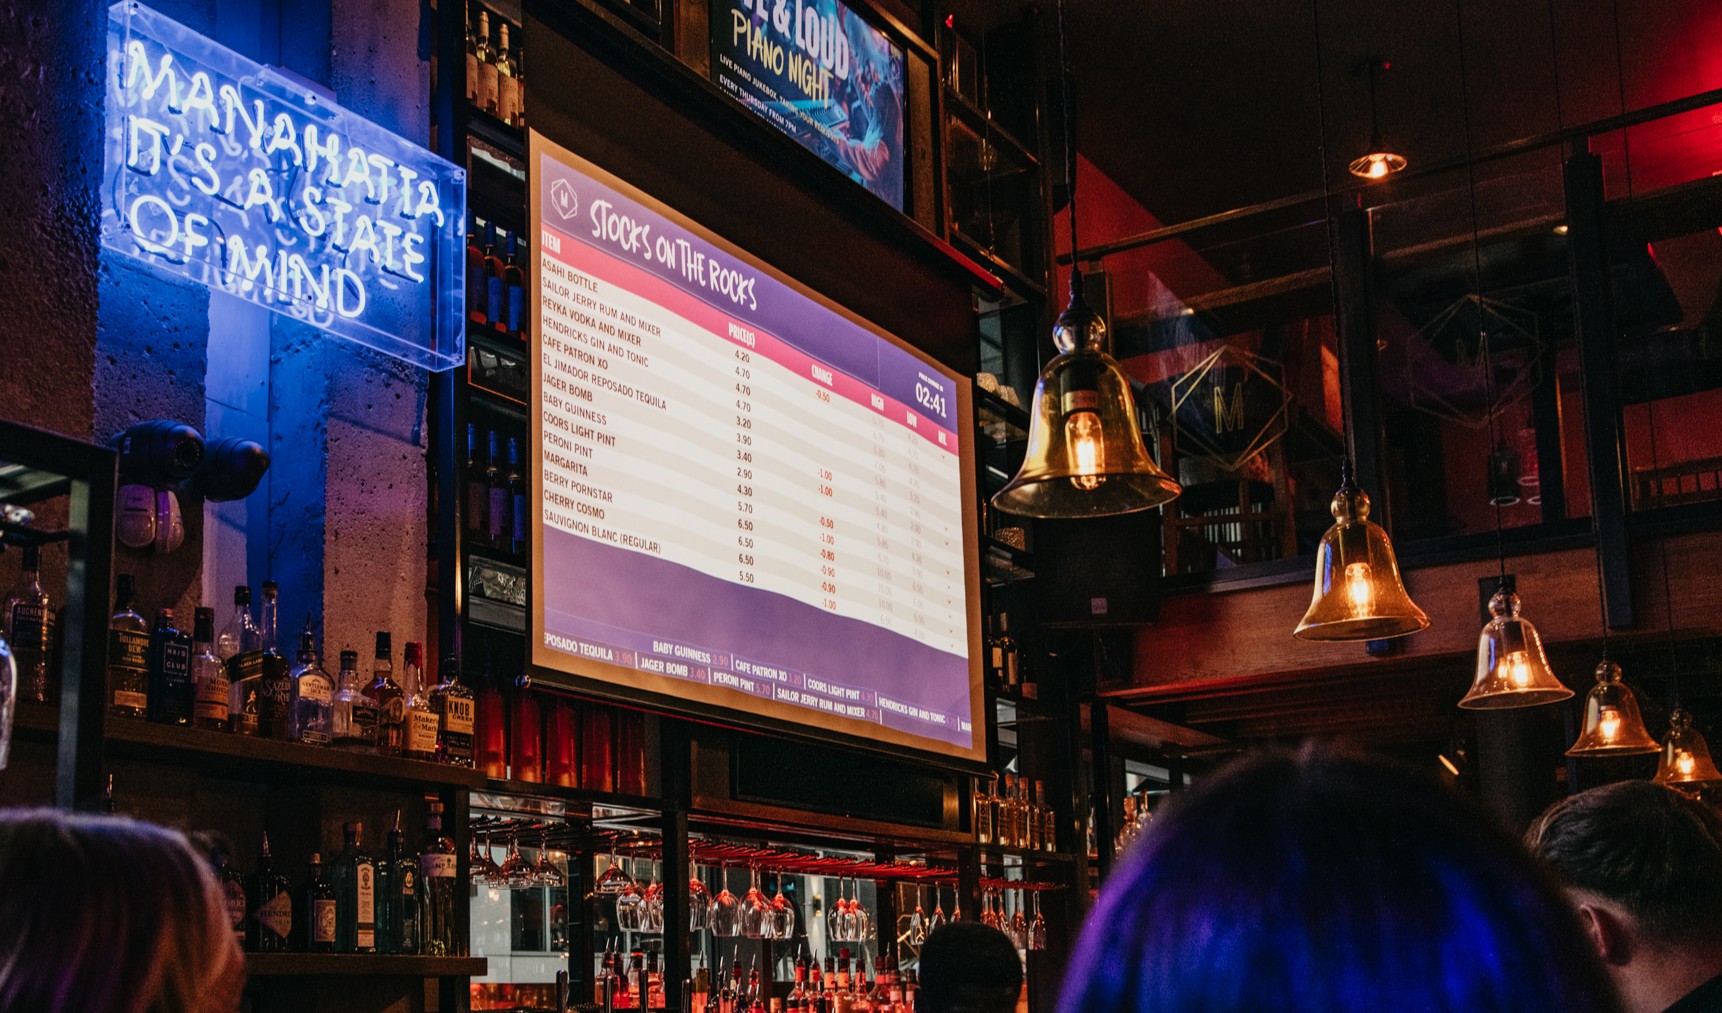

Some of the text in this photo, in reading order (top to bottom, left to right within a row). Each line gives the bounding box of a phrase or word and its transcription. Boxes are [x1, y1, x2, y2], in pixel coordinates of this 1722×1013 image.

[719, 53, 733, 69] LIVE
[734, 64, 752, 82] PIANO
[731, 8, 834, 110] PIANO NIGHT
[773, 0, 849, 80] & LOUD
[126, 40, 444, 227] MANAHATTA
[719, 73, 739, 93] EVERY
[739, 88, 768, 113] THURSDAY
[768, 106, 785, 125] FROM
[785, 118, 797, 134] 7PM
[128, 115, 424, 283] IT'S A STATE
[560, 190, 568, 208] M
[130, 195, 366, 318] OF MIND
[590, 199, 757, 311] STOCKS ON THE ROCKS
[541, 229, 561, 254] ITEM
[811, 363, 833, 387] CHANGE
[542, 258, 565, 278] ASAHI
[567, 267, 598, 293] BOTTLE
[734, 350, 750, 363] 4.20
[542, 276, 751, 380] SAILOR JERRY RUM AND MIXER 4.70
[542, 295, 751, 396] REYKA VODKA AND MIXER 4.70
[542, 315, 751, 413] HENDRICKS GIN AND TONIC 4.70
[542, 333, 561, 351] CAFE
[564, 345, 595, 366] PATRON
[597, 357, 608, 370] XO
[736, 416, 752, 430] 3.20
[915, 381, 947, 418] 02:41
[1213, 381, 1245, 435] M
[543, 354, 552, 367] EL
[554, 359, 589, 381] JIMADOR
[591, 374, 633, 398] REPOSADO
[636, 389, 667, 411] TEQUILA
[737, 433, 752, 446] 3.90
[817, 468, 833, 482] -1.00
[543, 372, 567, 392] JAGER
[569, 383, 593, 402] BOMB
[737, 450, 752, 463] 3.40
[818, 484, 833, 497] -1.00
[543, 392, 753, 480] BABY GUINNESS 2.90
[543, 410, 834, 529] COORS LIGHT PINT 4.30 -0.50
[543, 430, 835, 546] PERONI PINT 5.70 -1.00
[544, 449, 588, 477] MARGARITA
[738, 518, 753, 532] 6.50
[820, 548, 835, 561] -0.80
[544, 468, 569, 489] BERRY
[571, 480, 613, 504] PORNSTAR
[738, 535, 754, 549] 6.50
[820, 565, 835, 578] -0.90
[544, 489, 575, 511] CHERRY
[577, 501, 605, 520] COSMO
[739, 553, 754, 566] 6.50
[821, 581, 836, 594] -0.90
[544, 509, 589, 535] SAUVIGNON
[591, 526, 618, 543] BLANC
[620, 530, 661, 554] (REGULAR)
[739, 570, 754, 583] 5.50
[166, 660, 186, 670] CLUB
[167, 648, 186, 657] HAIG
[580, 643, 613, 661] TEQUILA
[615, 652, 632, 665] 3.90
[640, 657, 664, 674] JAGER
[666, 663, 688, 677] BOMB
[690, 666, 705, 680] 3.40
[714, 671, 739, 687] PERONI
[740, 679, 755, 692] PINT
[756, 681, 770, 694] 5.70
[777, 687, 799, 702] SAILOR
[800, 693, 818, 708] JERRY
[819, 699, 833, 711] RUM
[833, 702, 846, 714] AND
[847, 705, 865, 718] MIXER
[653, 640, 673, 655] BABY
[675, 645, 711, 664] GUINNESS
[713, 653, 728, 666] 2.90
[735, 659, 751, 673] CAFE
[752, 664, 778, 680] PATRON
[778, 670, 787, 682] XO
[808, 678, 827, 693] COORS
[828, 684, 845, 698] LIGHT
[846, 688, 860, 700] PINT
[879, 696, 908, 715] HENDRICKS
[909, 705, 918, 717] GIN
[918, 707, 930, 720] AND
[930, 711, 946, 724] TONIC
[449, 700, 470, 717] KNOB
